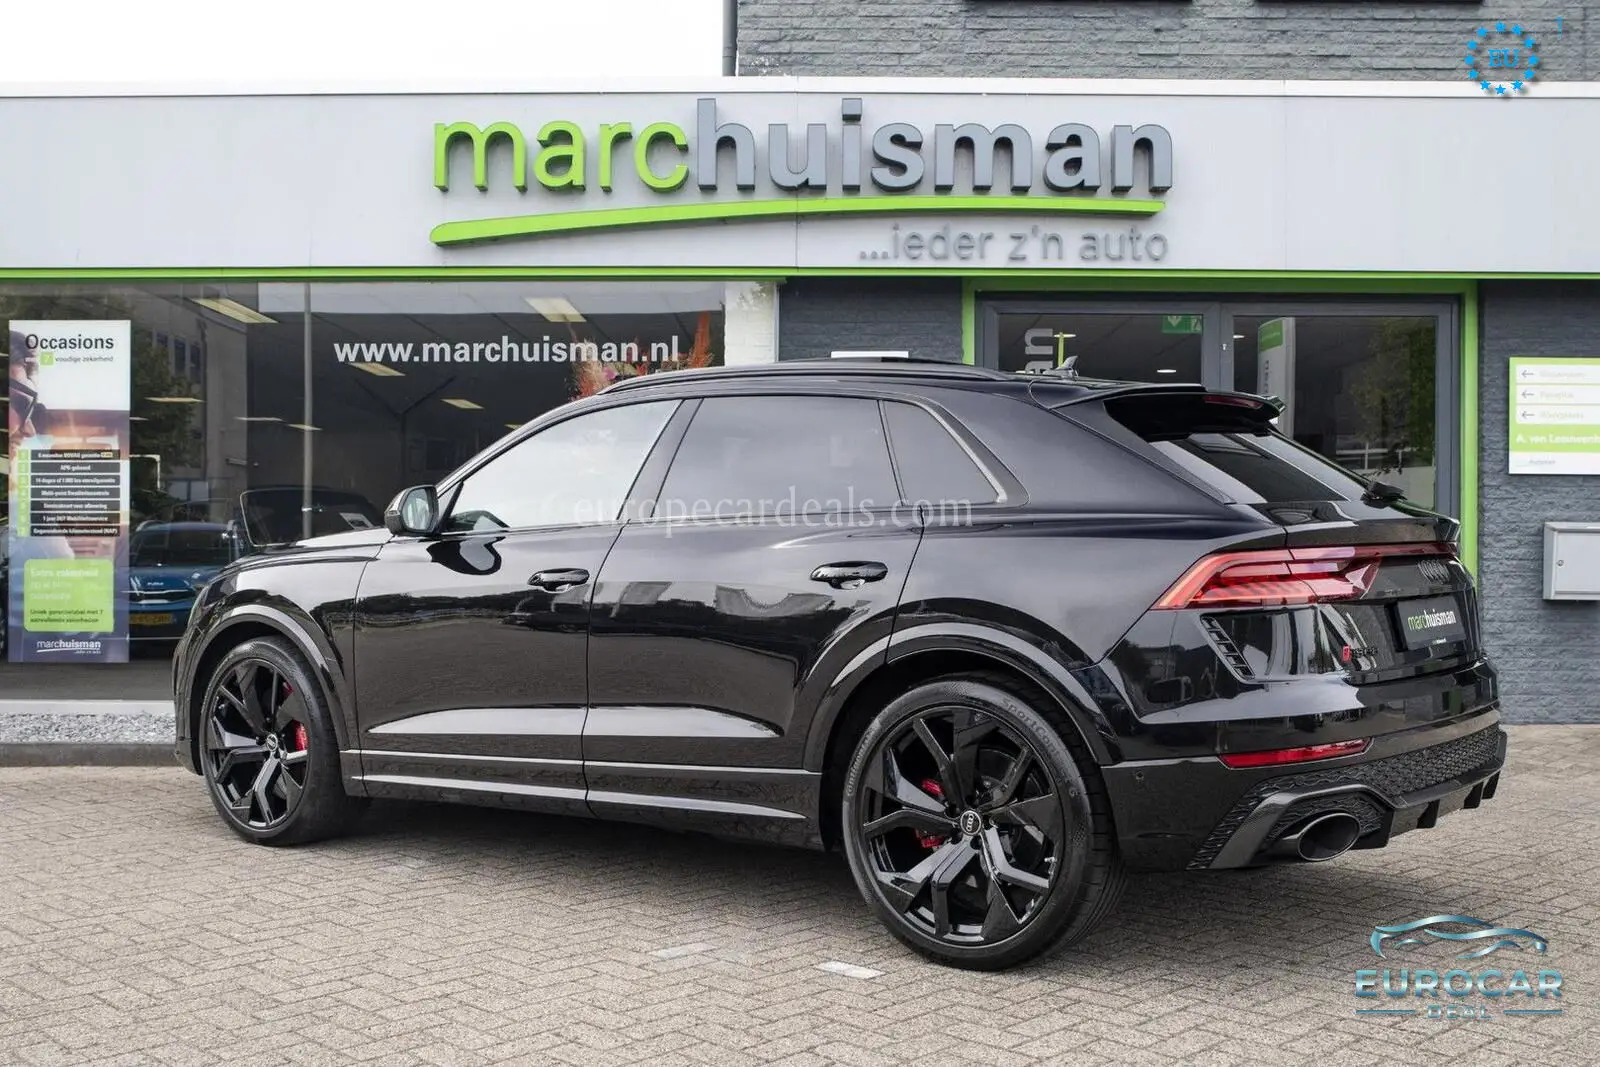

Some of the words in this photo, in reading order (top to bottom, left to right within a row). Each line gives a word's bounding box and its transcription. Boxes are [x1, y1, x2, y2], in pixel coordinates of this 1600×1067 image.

[433, 97, 1174, 194] marchuisman
[1009, 225, 1064, 261] z'n
[1080, 225, 1168, 261] auto
[25, 334, 114, 350] Occasions
[333, 335, 679, 362] www.marchuisman.nl
[1407, 608, 1457, 632] marchuisman
[36, 638, 102, 649] marchuisman
